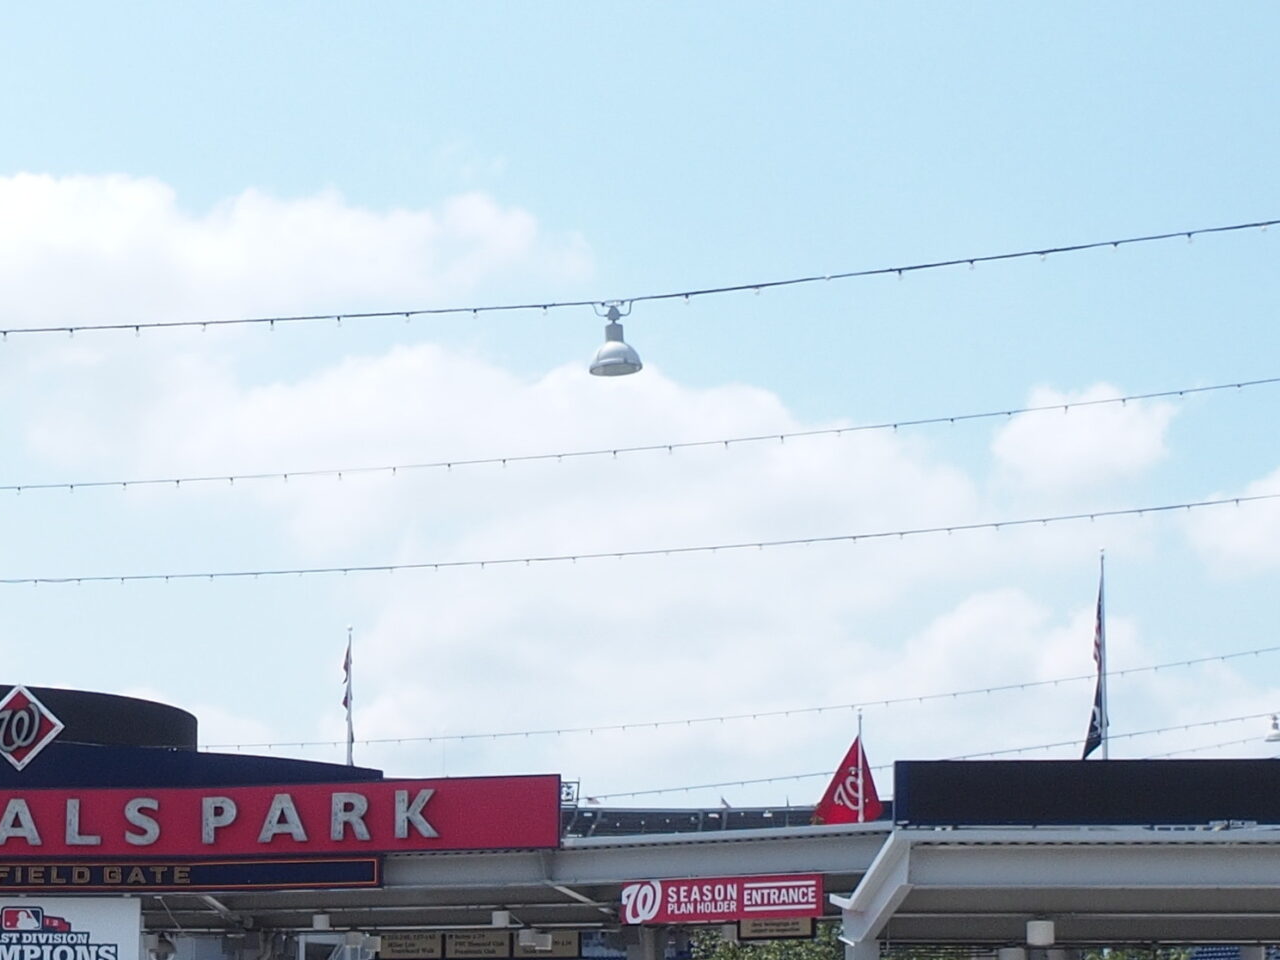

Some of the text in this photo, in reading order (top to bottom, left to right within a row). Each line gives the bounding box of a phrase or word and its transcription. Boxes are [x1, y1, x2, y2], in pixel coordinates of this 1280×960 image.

[202, 789, 440, 844] PARK
[103, 866, 192, 884] GATE
[667, 883, 737, 903] SEASON
[743, 886, 816, 905] ENTRANCE
[667, 901, 737, 915] PLAN HOLDER
[22, 932, 88, 944] DIVISION
